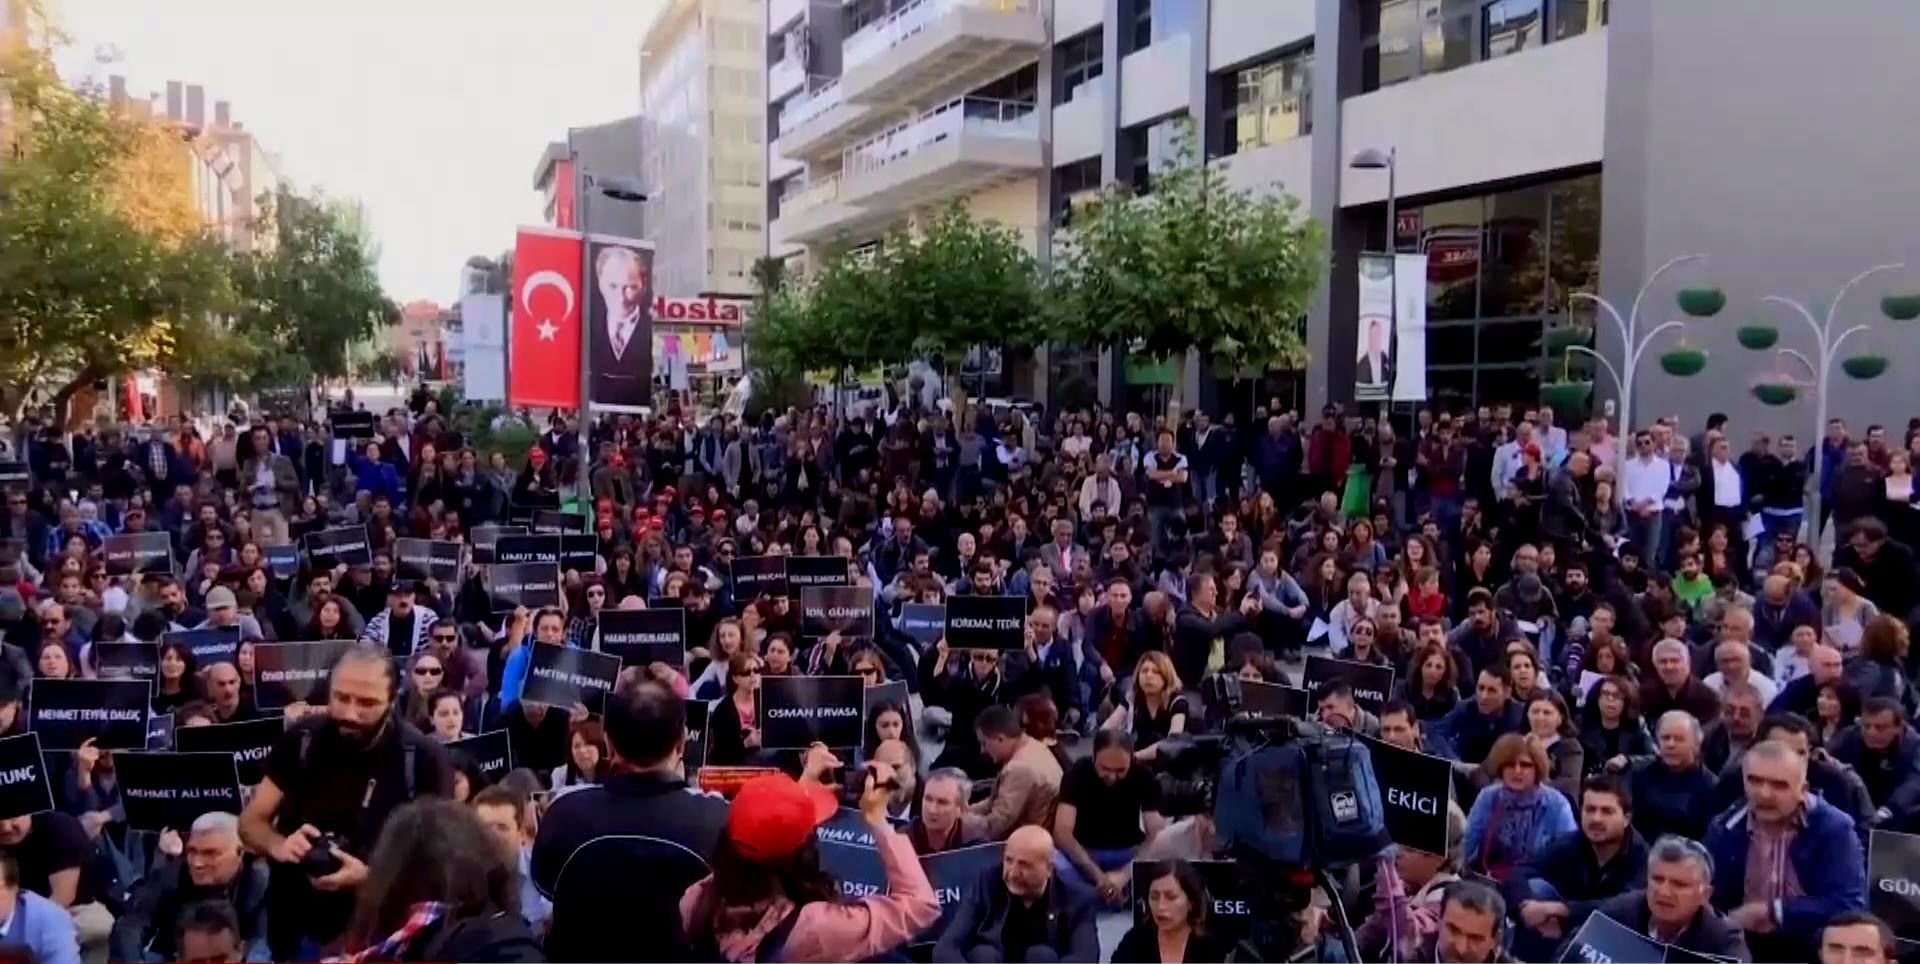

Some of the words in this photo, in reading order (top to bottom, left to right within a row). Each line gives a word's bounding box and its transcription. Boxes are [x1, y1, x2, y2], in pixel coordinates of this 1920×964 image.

[501, 552, 532, 560] UMUT
[536, 552, 556, 561] TAN
[768, 708, 813, 718] OSMAN
[817, 707, 858, 718] ERVASA
[127, 788, 176, 798] MEHMET
